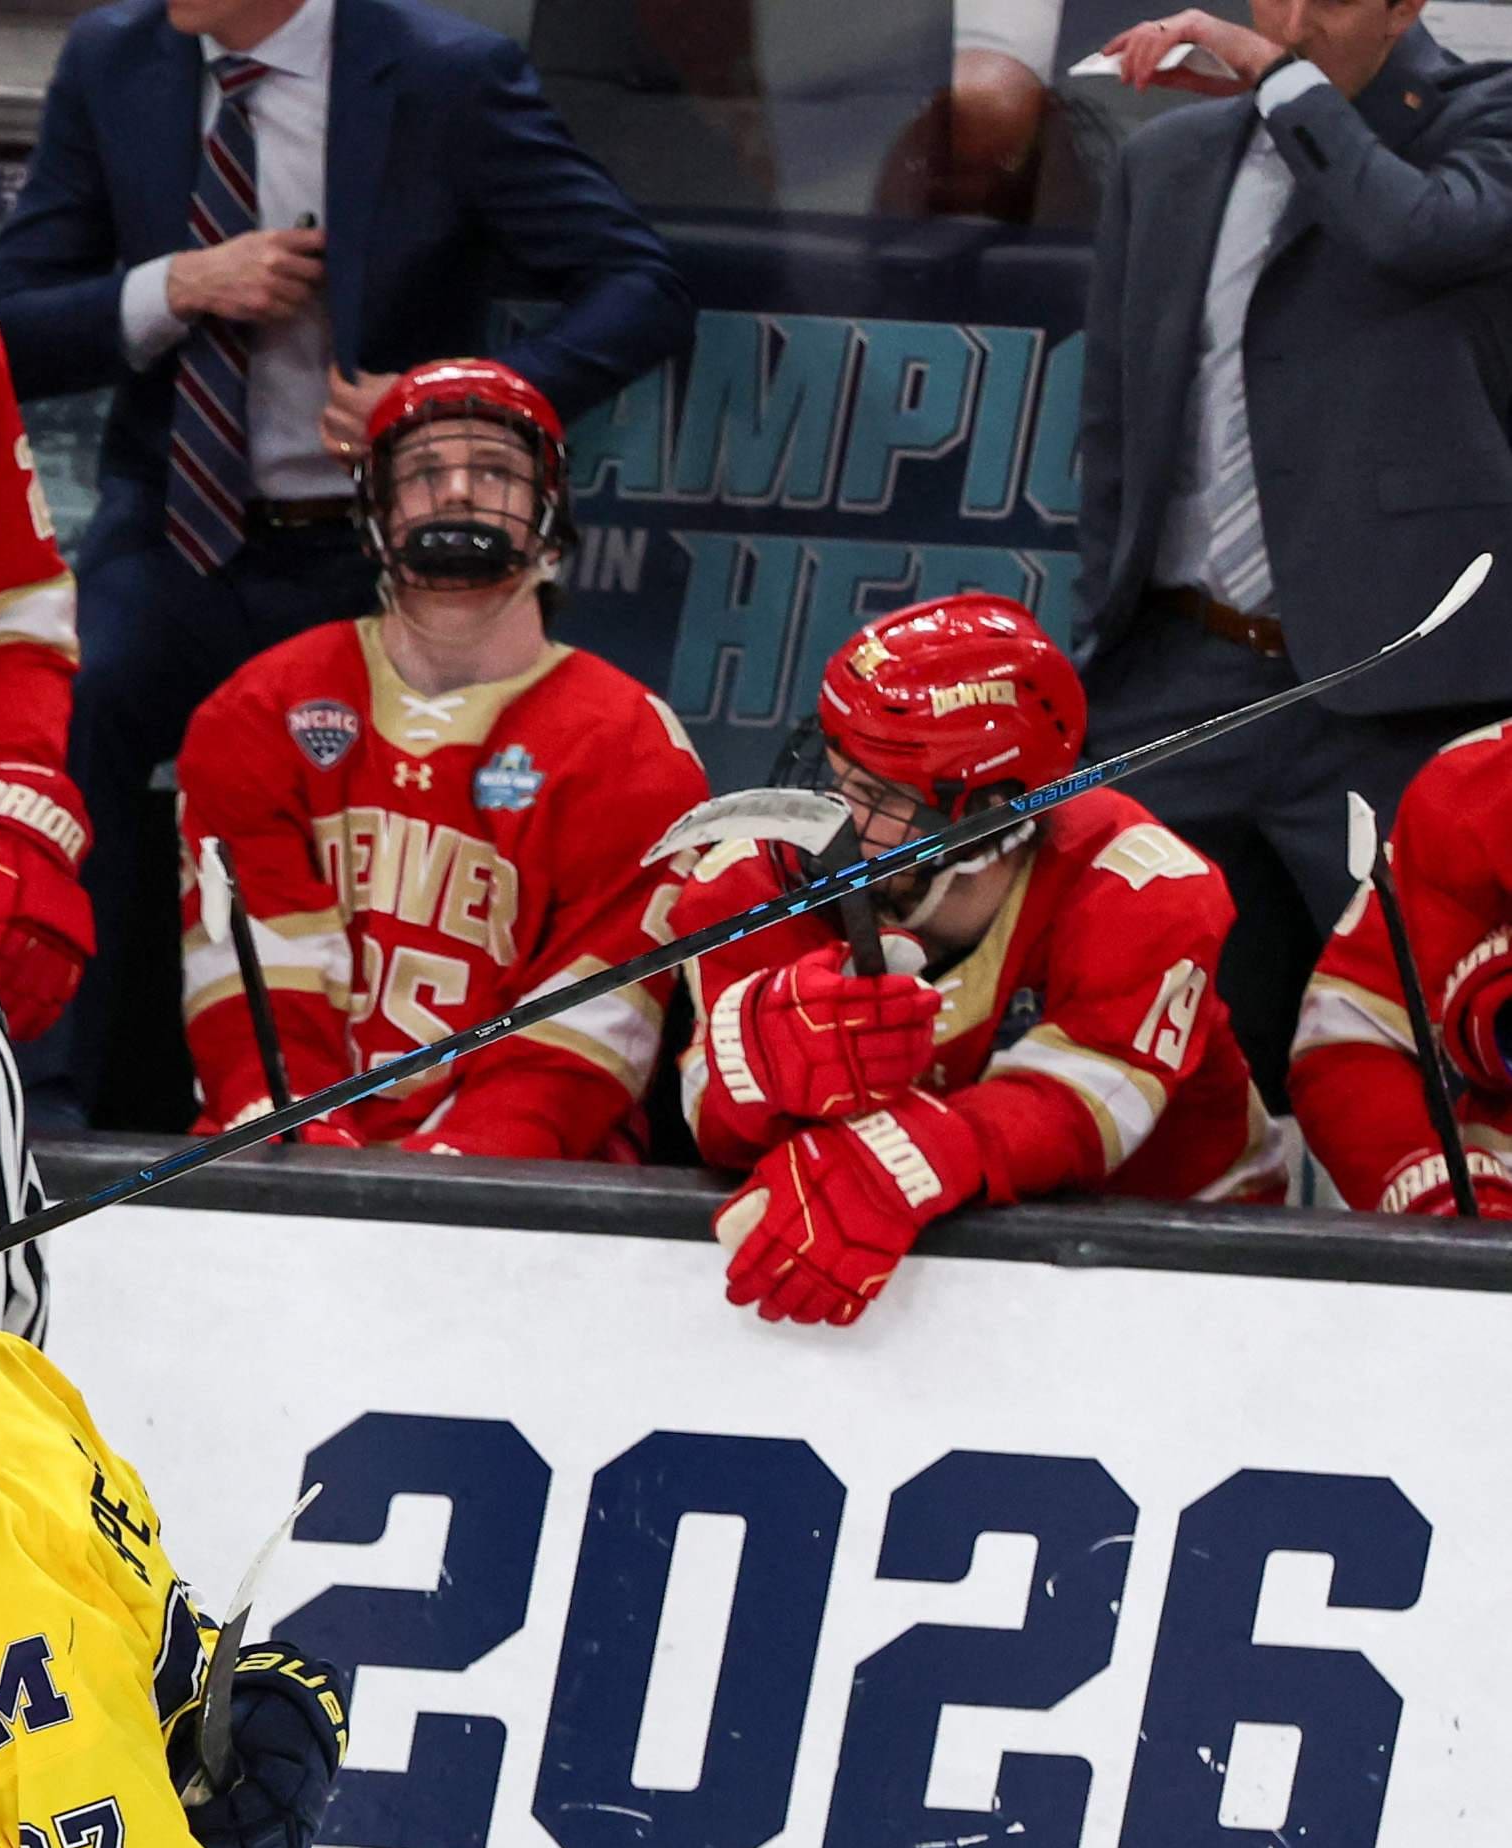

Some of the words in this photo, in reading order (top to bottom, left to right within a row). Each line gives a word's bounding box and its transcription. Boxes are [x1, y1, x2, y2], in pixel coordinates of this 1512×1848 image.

[930, 679, 1020, 719] DENVER
[311, 806, 518, 967] DENVER
[1132, 957, 1208, 1072] 19
